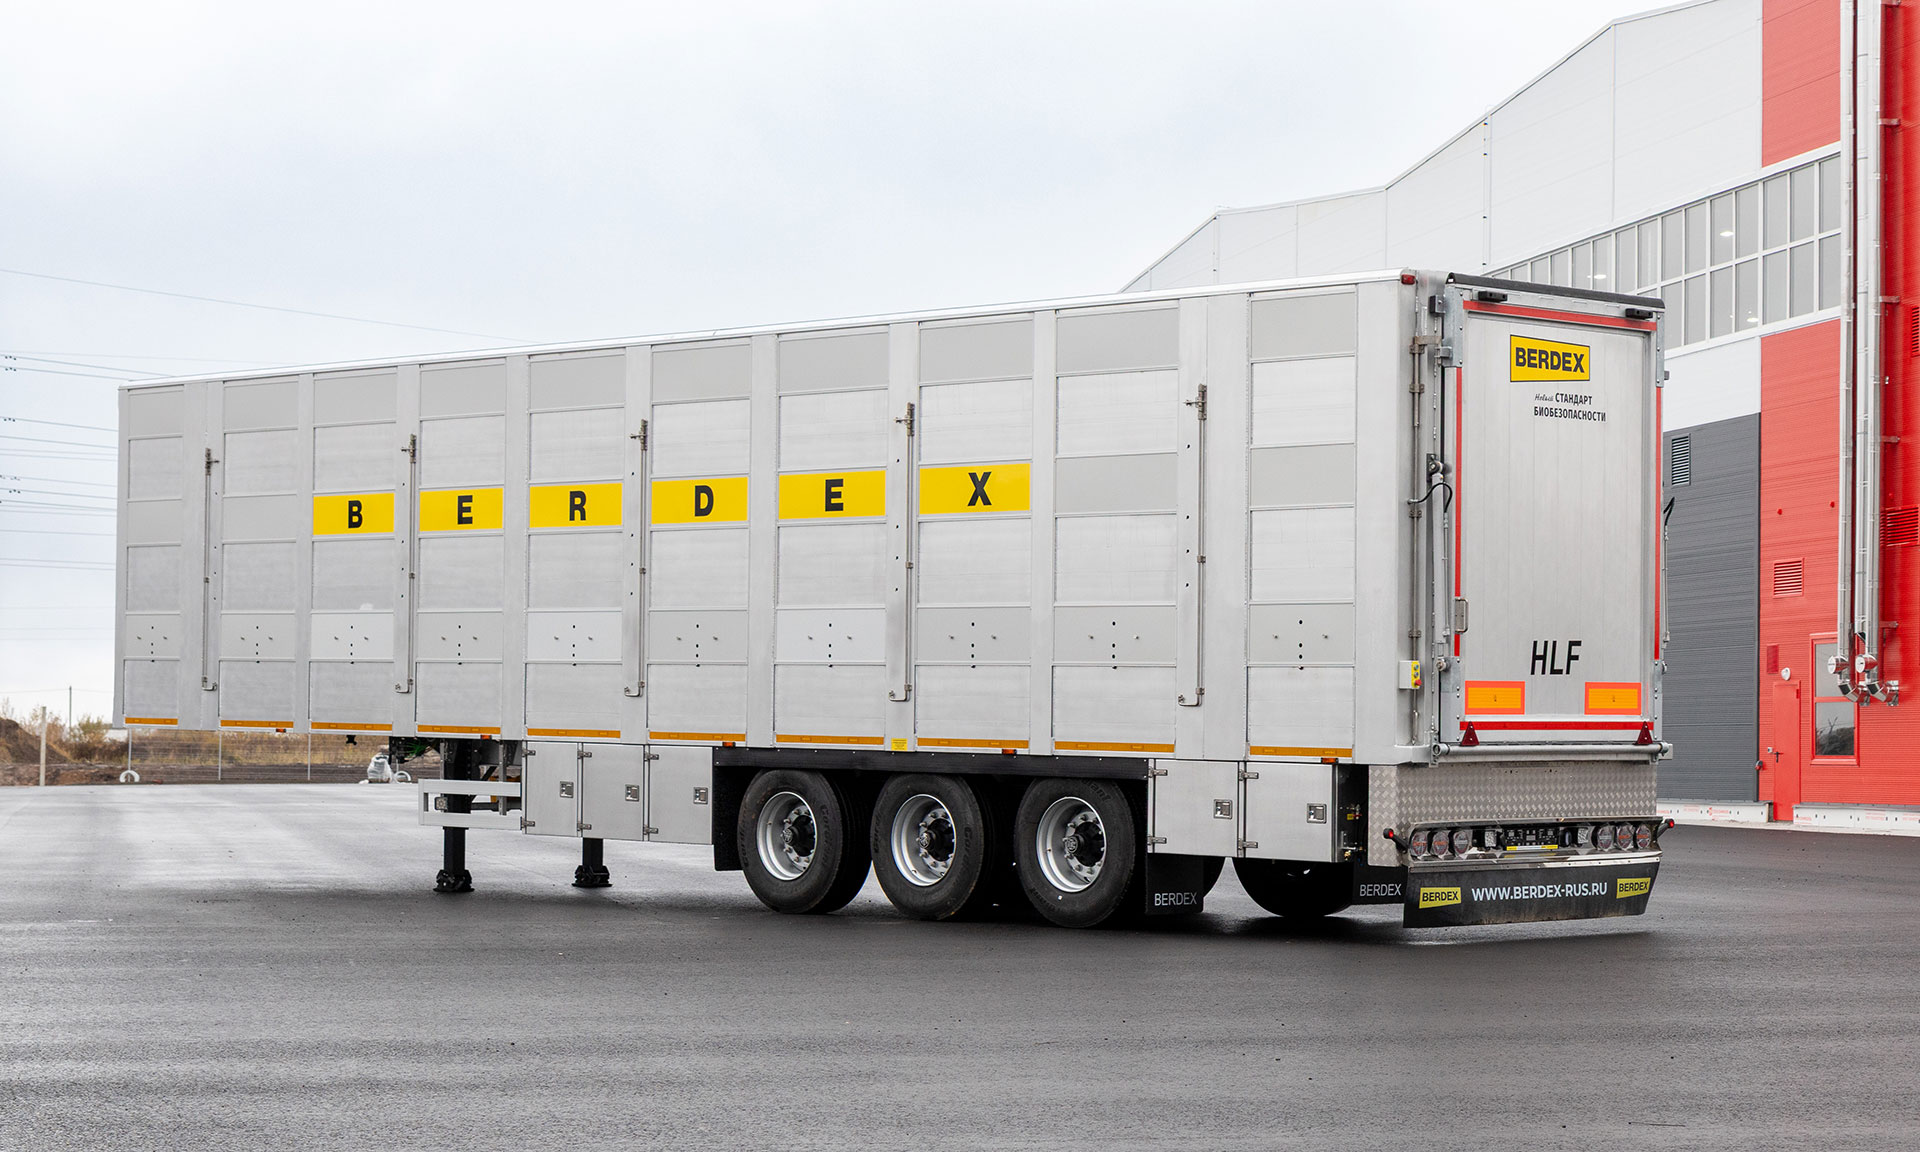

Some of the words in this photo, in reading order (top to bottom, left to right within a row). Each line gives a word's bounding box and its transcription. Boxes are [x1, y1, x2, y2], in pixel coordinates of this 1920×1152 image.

[1515, 346, 1585, 373] BERDEX
[1555, 392, 1593, 406] СТАНДАРТ
[1533, 406, 1606, 422] БИОБЕЗОПАСНОСТИ
[1530, 640, 1582, 676] HLF
[1359, 883, 1402, 897] BERDEX
[1471, 881, 1608, 902] WWW.BERDEX-RUS.RU
[1618, 880, 1650, 893] BERDEX
[1154, 892, 1197, 906] BERDEX
[1422, 890, 1459, 903] BERDEX
